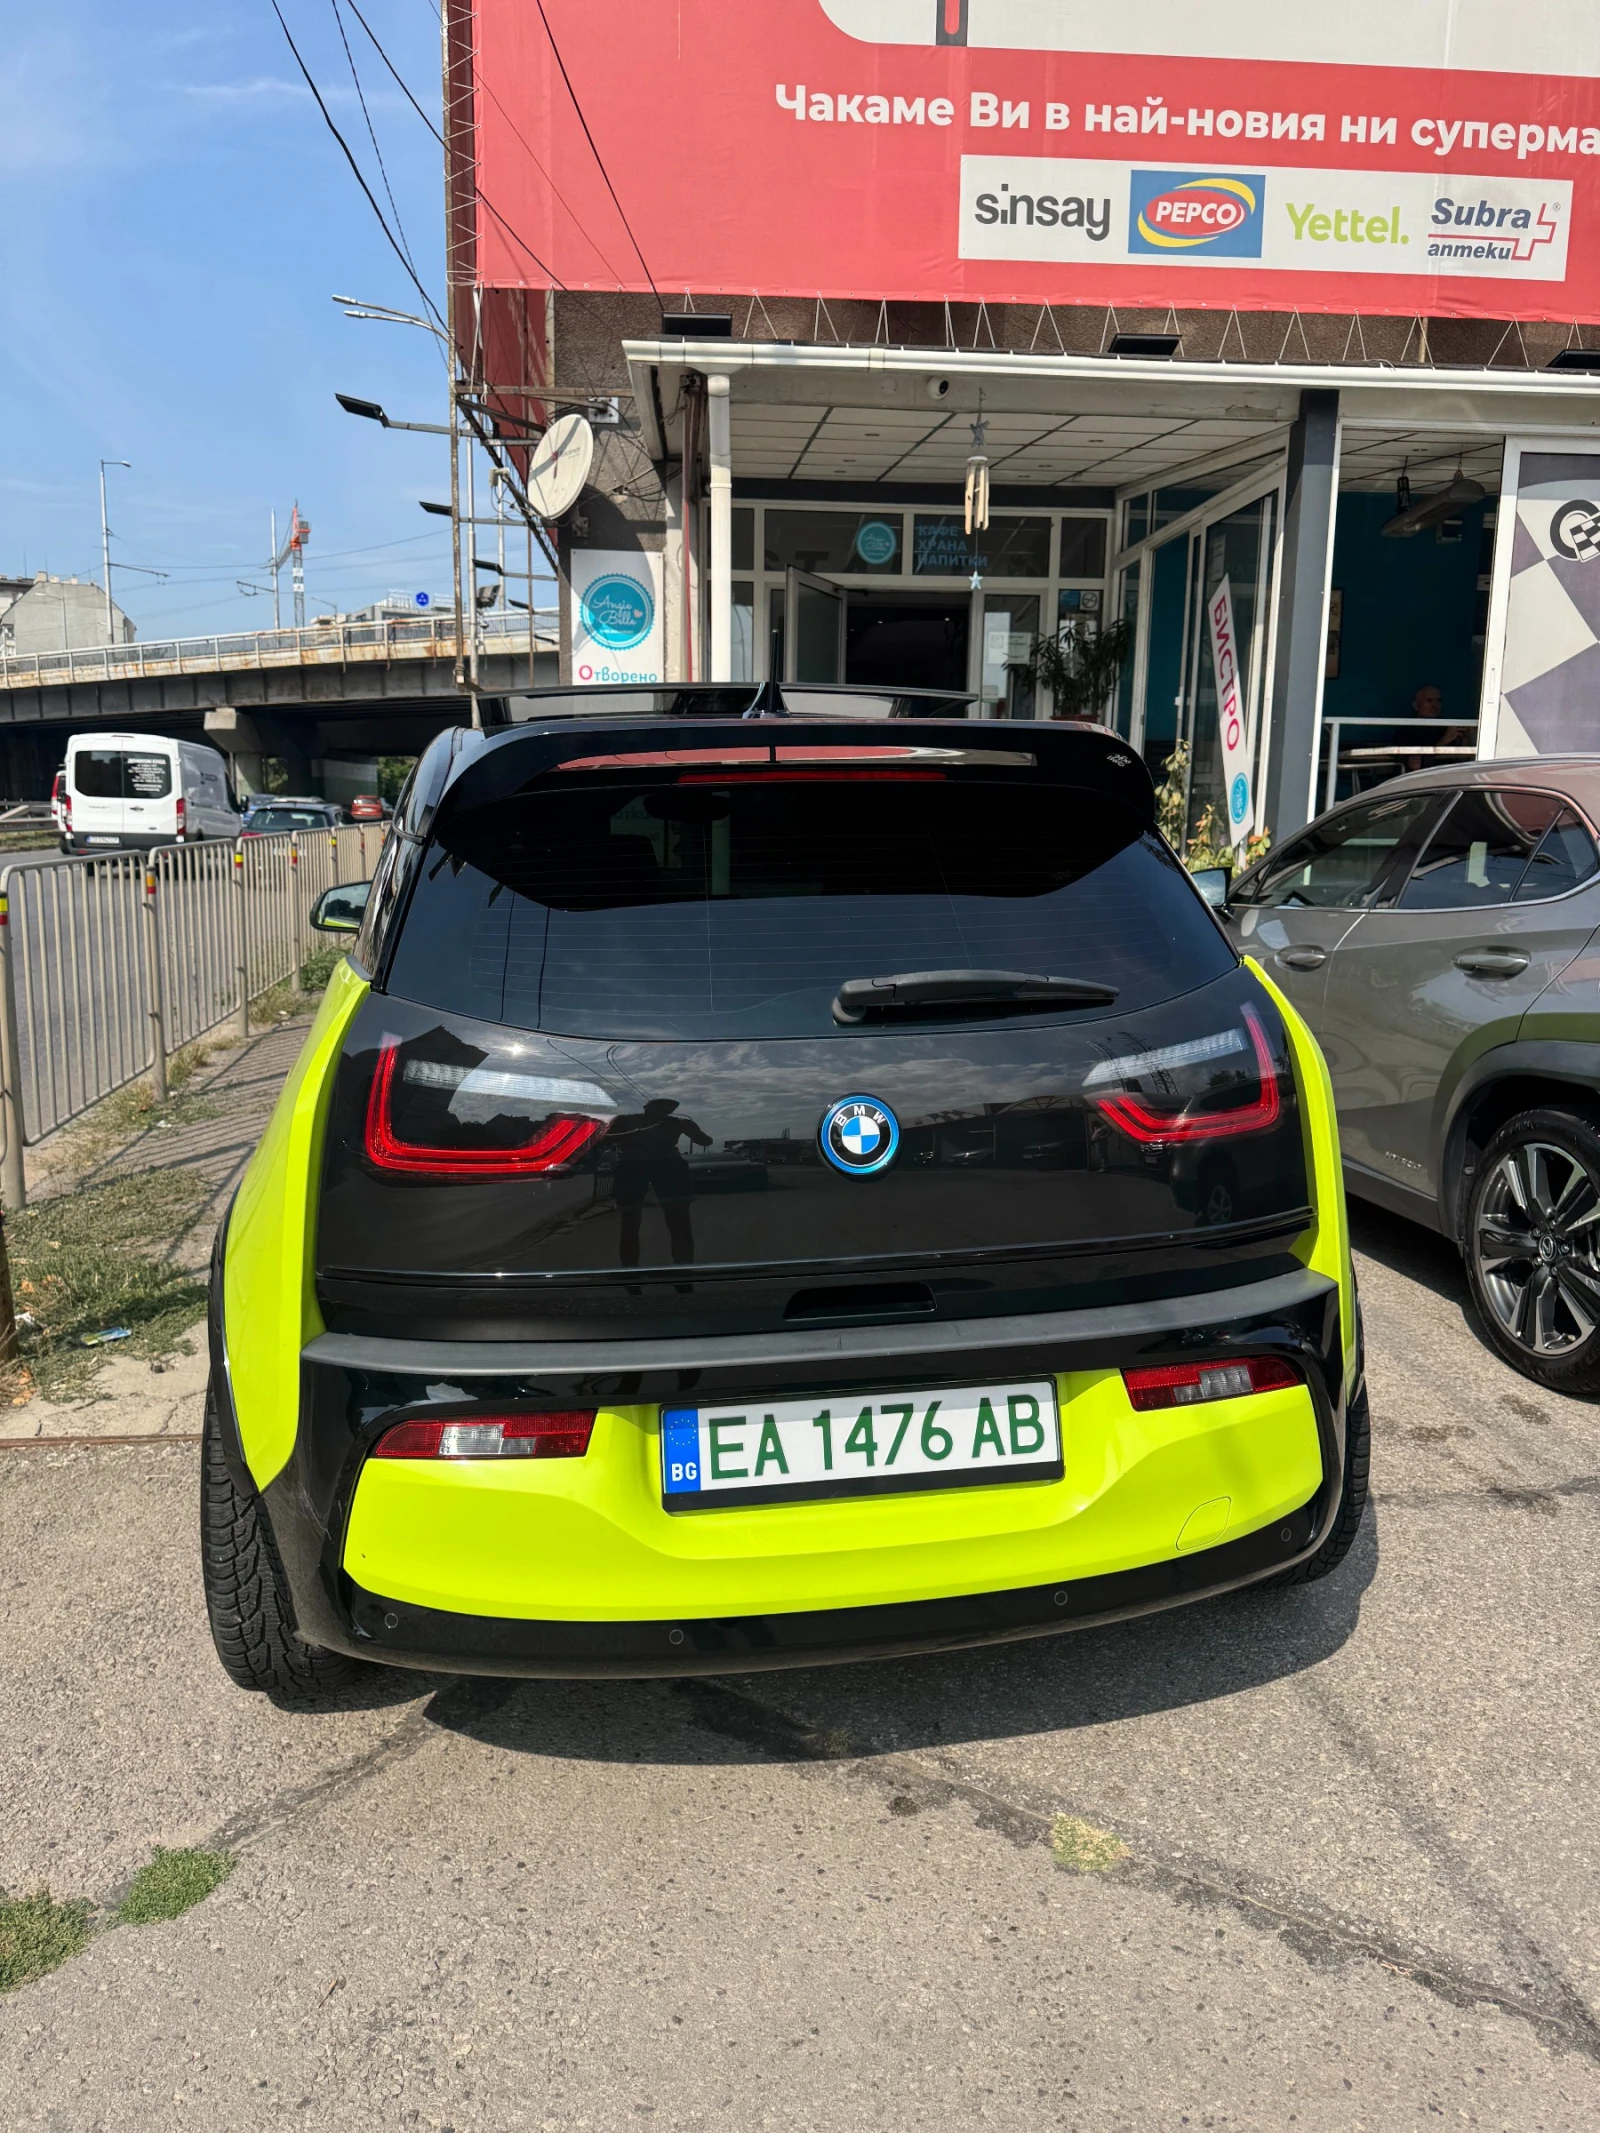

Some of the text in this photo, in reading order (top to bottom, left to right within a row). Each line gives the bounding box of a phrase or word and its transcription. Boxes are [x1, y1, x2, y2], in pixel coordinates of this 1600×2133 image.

[775, 84, 1600, 160] Чакаме Ви в най-новия ни суперма
[975, 184, 1111, 242] sinsay
[1155, 201, 1238, 225] PEPCO
[1431, 198, 1532, 229] Subra
[918, 525, 959, 537] КАФЕ
[918, 540, 967, 552] ХРАНА
[579, 665, 658, 684] Отворено
[1214, 594, 1240, 751] БИСТРО
[835, 1105, 886, 1127] BMW
[708, 1394, 1045, 1481] EA 1476 AB
[671, 1462, 698, 1482] BG
